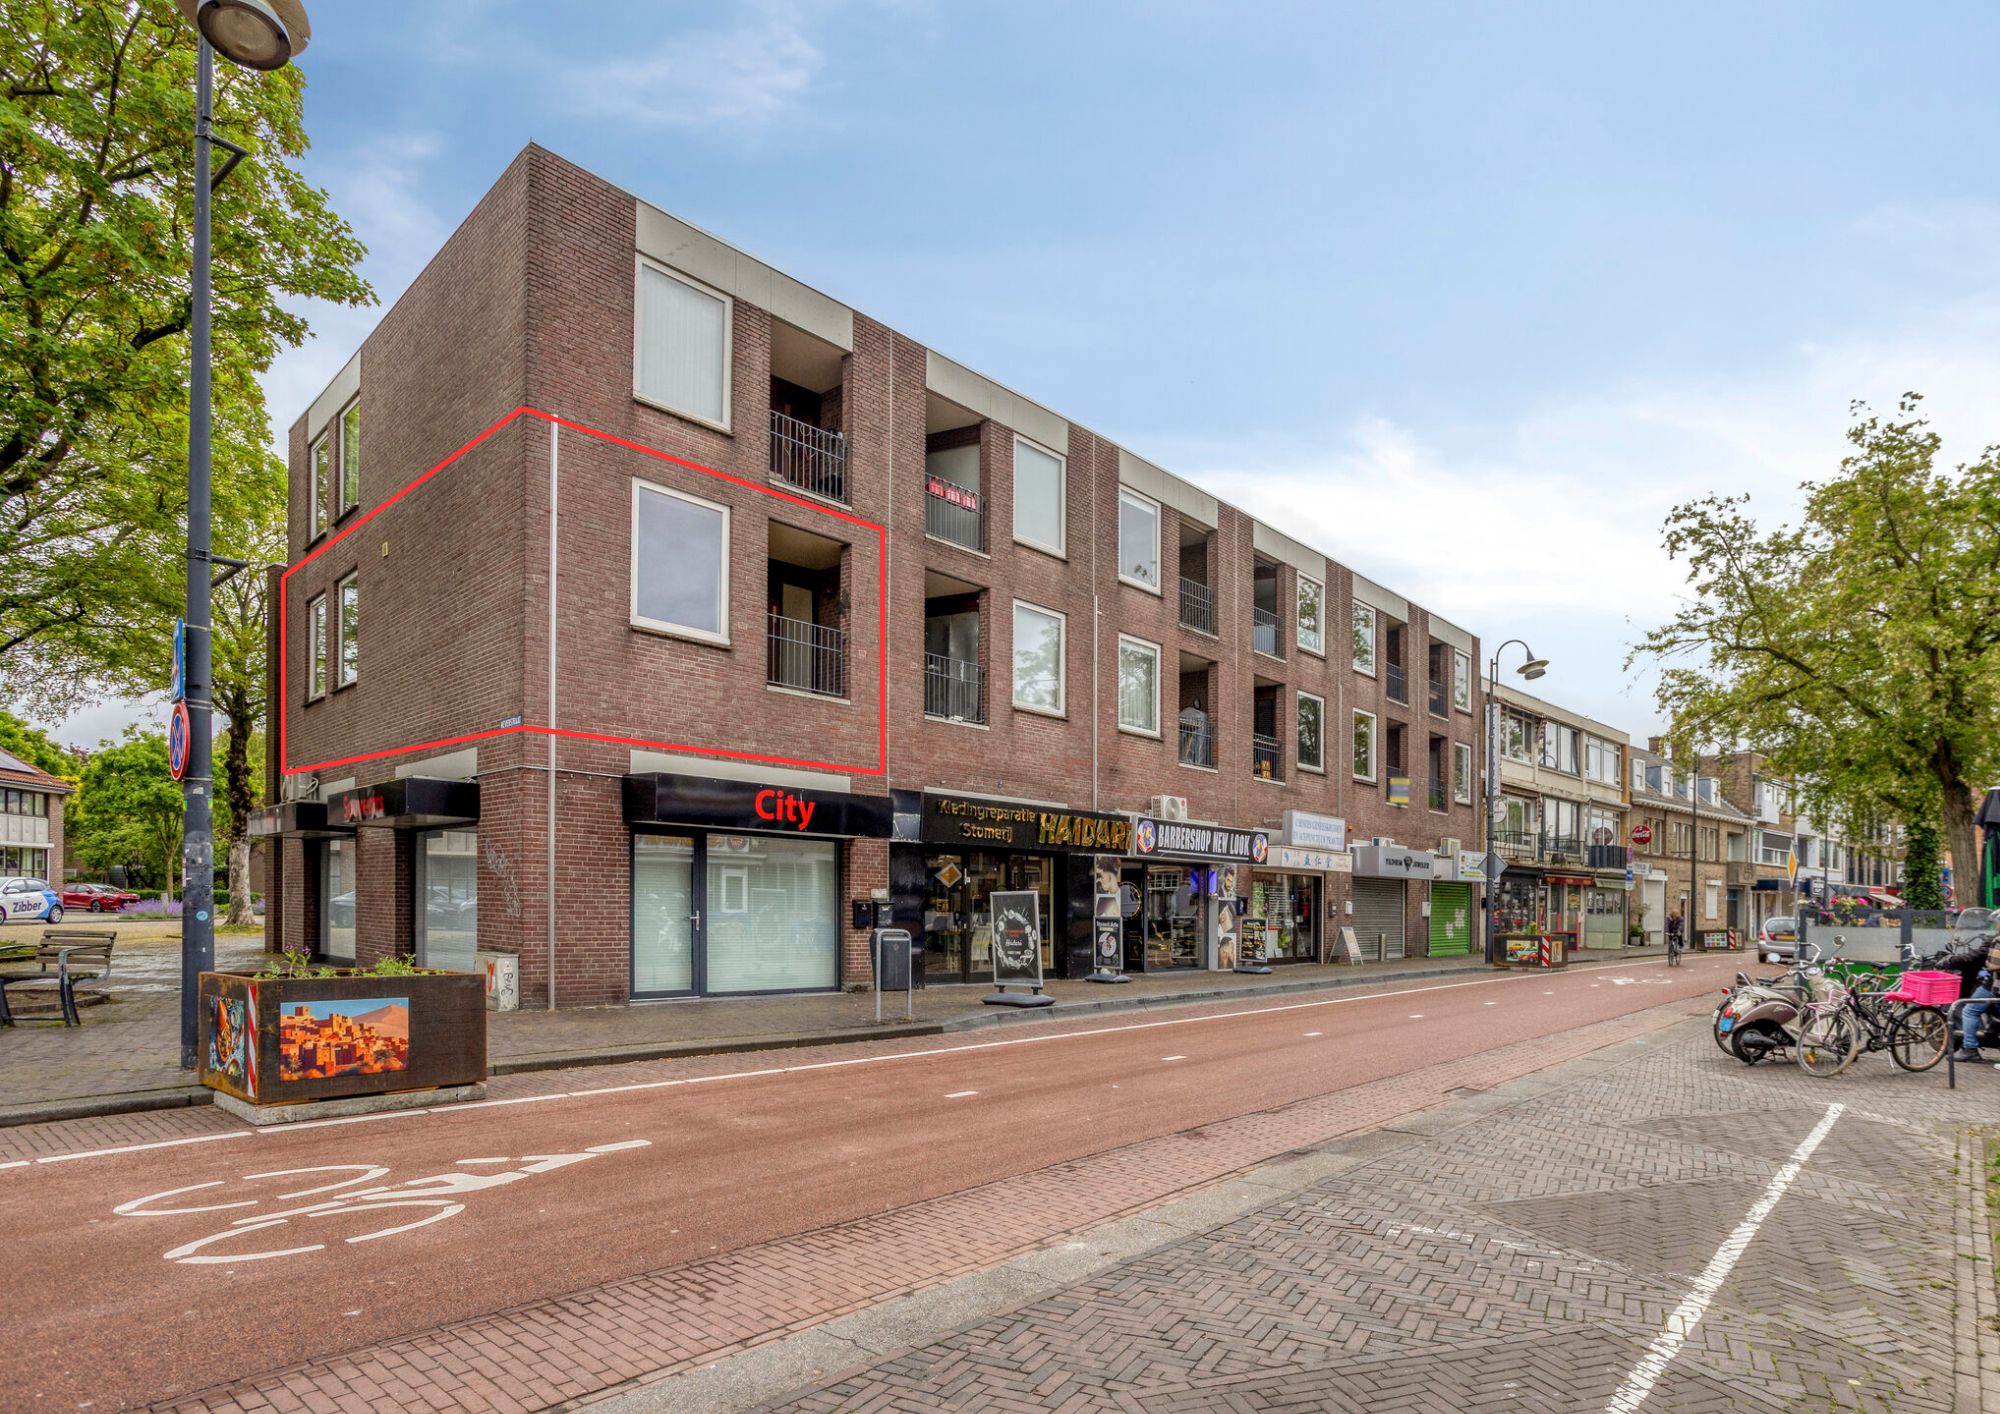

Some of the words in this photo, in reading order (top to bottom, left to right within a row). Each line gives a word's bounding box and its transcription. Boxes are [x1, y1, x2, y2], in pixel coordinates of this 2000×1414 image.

[755, 789, 816, 831] City
[939, 800, 1036, 822] Kledingreparatie
[962, 823, 1013, 843] Stomerij
[1158, 825, 1211, 852] BARBERSHOP
[1212, 831, 1229, 854] NEW
[1230, 834, 1250, 855] LOOK
[13, 900, 42, 913] Zibber
